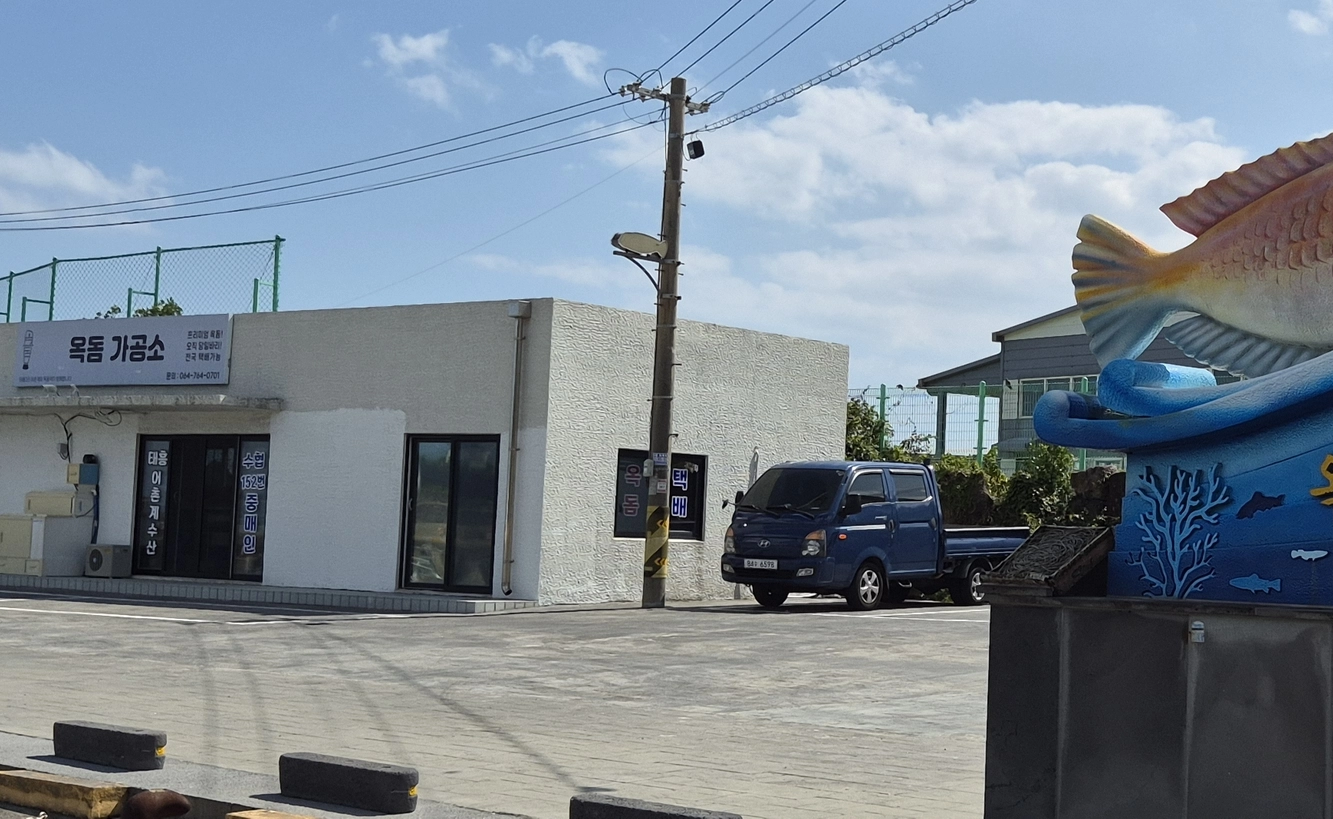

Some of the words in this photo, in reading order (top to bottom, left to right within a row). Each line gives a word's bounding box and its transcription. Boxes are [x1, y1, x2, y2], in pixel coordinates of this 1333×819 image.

[69, 336, 104, 363] 옥돔
[110, 334, 165, 362] 가공소
[186, 341, 197, 351] 오직
[185, 352, 197, 362] 전국
[148, 450, 168, 466] 태흥
[242, 451, 265, 469] 수협
[240, 474, 265, 490] 152번
[671, 467, 688, 518] 택배
[244, 493, 258, 554] 중매인
